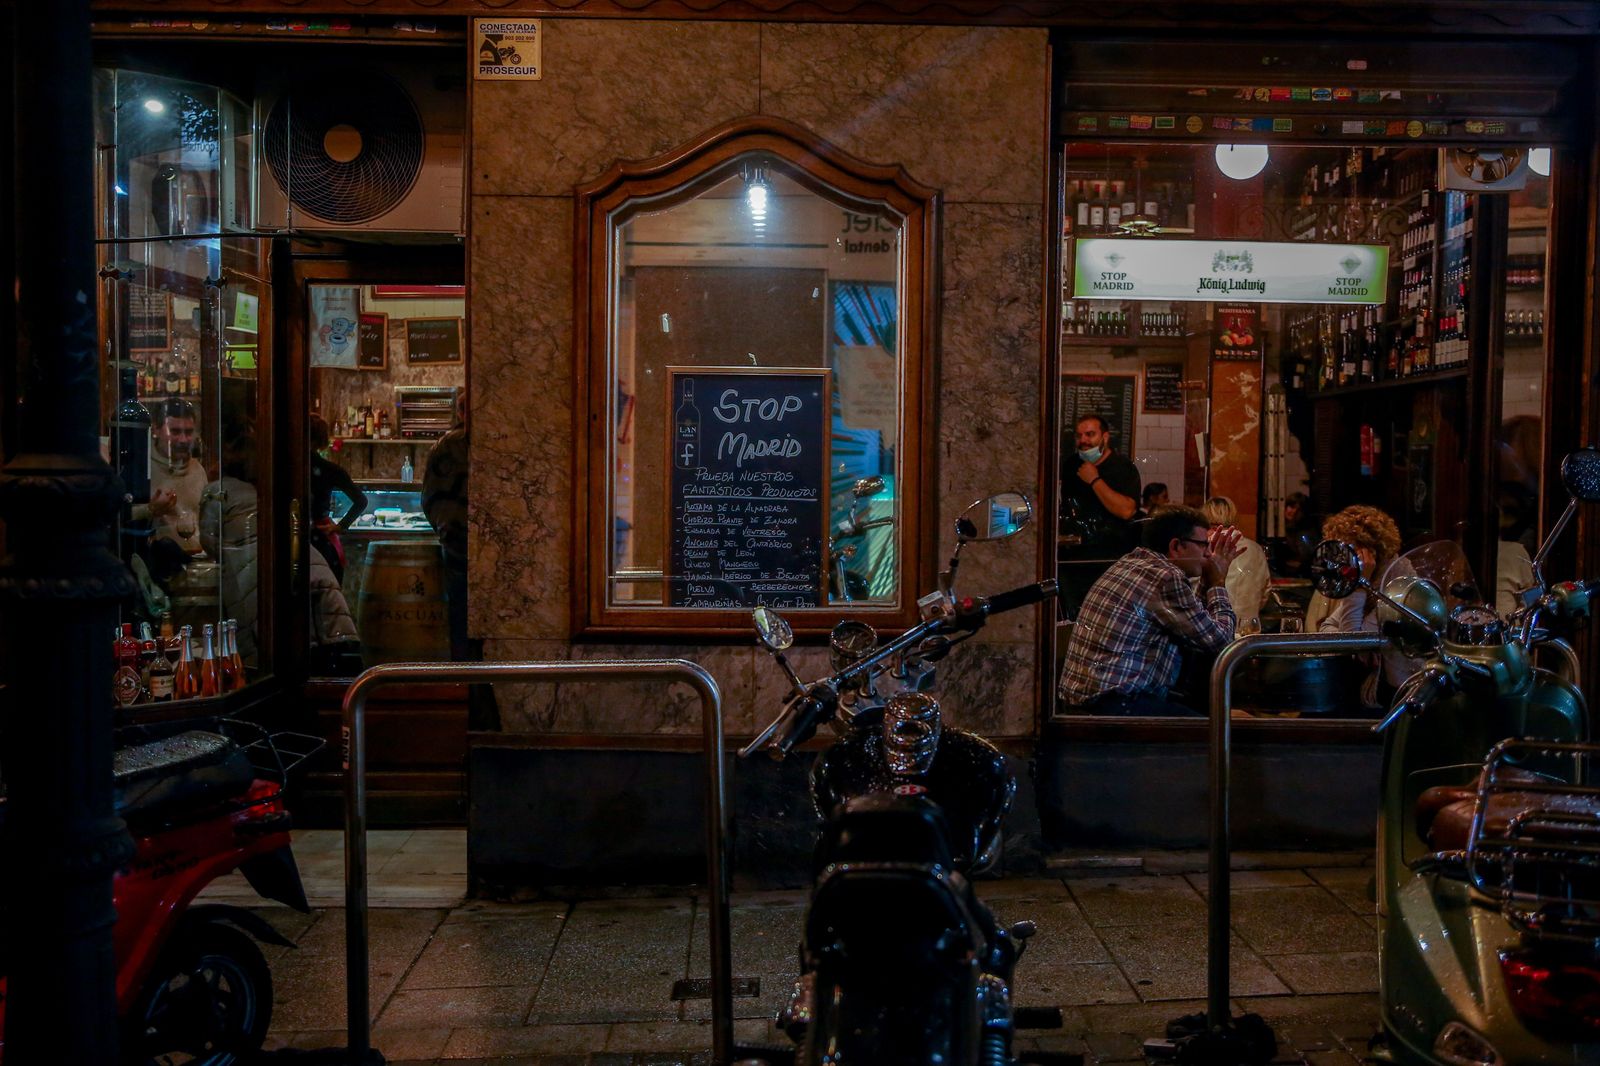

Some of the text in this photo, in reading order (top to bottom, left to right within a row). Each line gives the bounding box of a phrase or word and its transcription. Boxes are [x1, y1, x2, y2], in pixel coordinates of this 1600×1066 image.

[1101, 272, 1127, 281] STOP
[1336, 277, 1362, 286] STOP
[1093, 281, 1134, 291] MADRID
[1197, 277, 1266, 294] König Ludwig
[1328, 287, 1368, 296] MADRID
[712, 388, 803, 424] STOP
[717, 431, 803, 468] MADRID
[695, 467, 795, 482] PRUEBA NUESTROS
[760, 483, 817, 497] PRODUCTOS
[717, 504, 728, 512] DE
[730, 503, 741, 512] LA
[682, 513, 714, 524] CHORIZO
[764, 515, 798, 526] ZAMORA
[723, 539, 739, 548] DEL
[760, 571, 770, 579] DE
